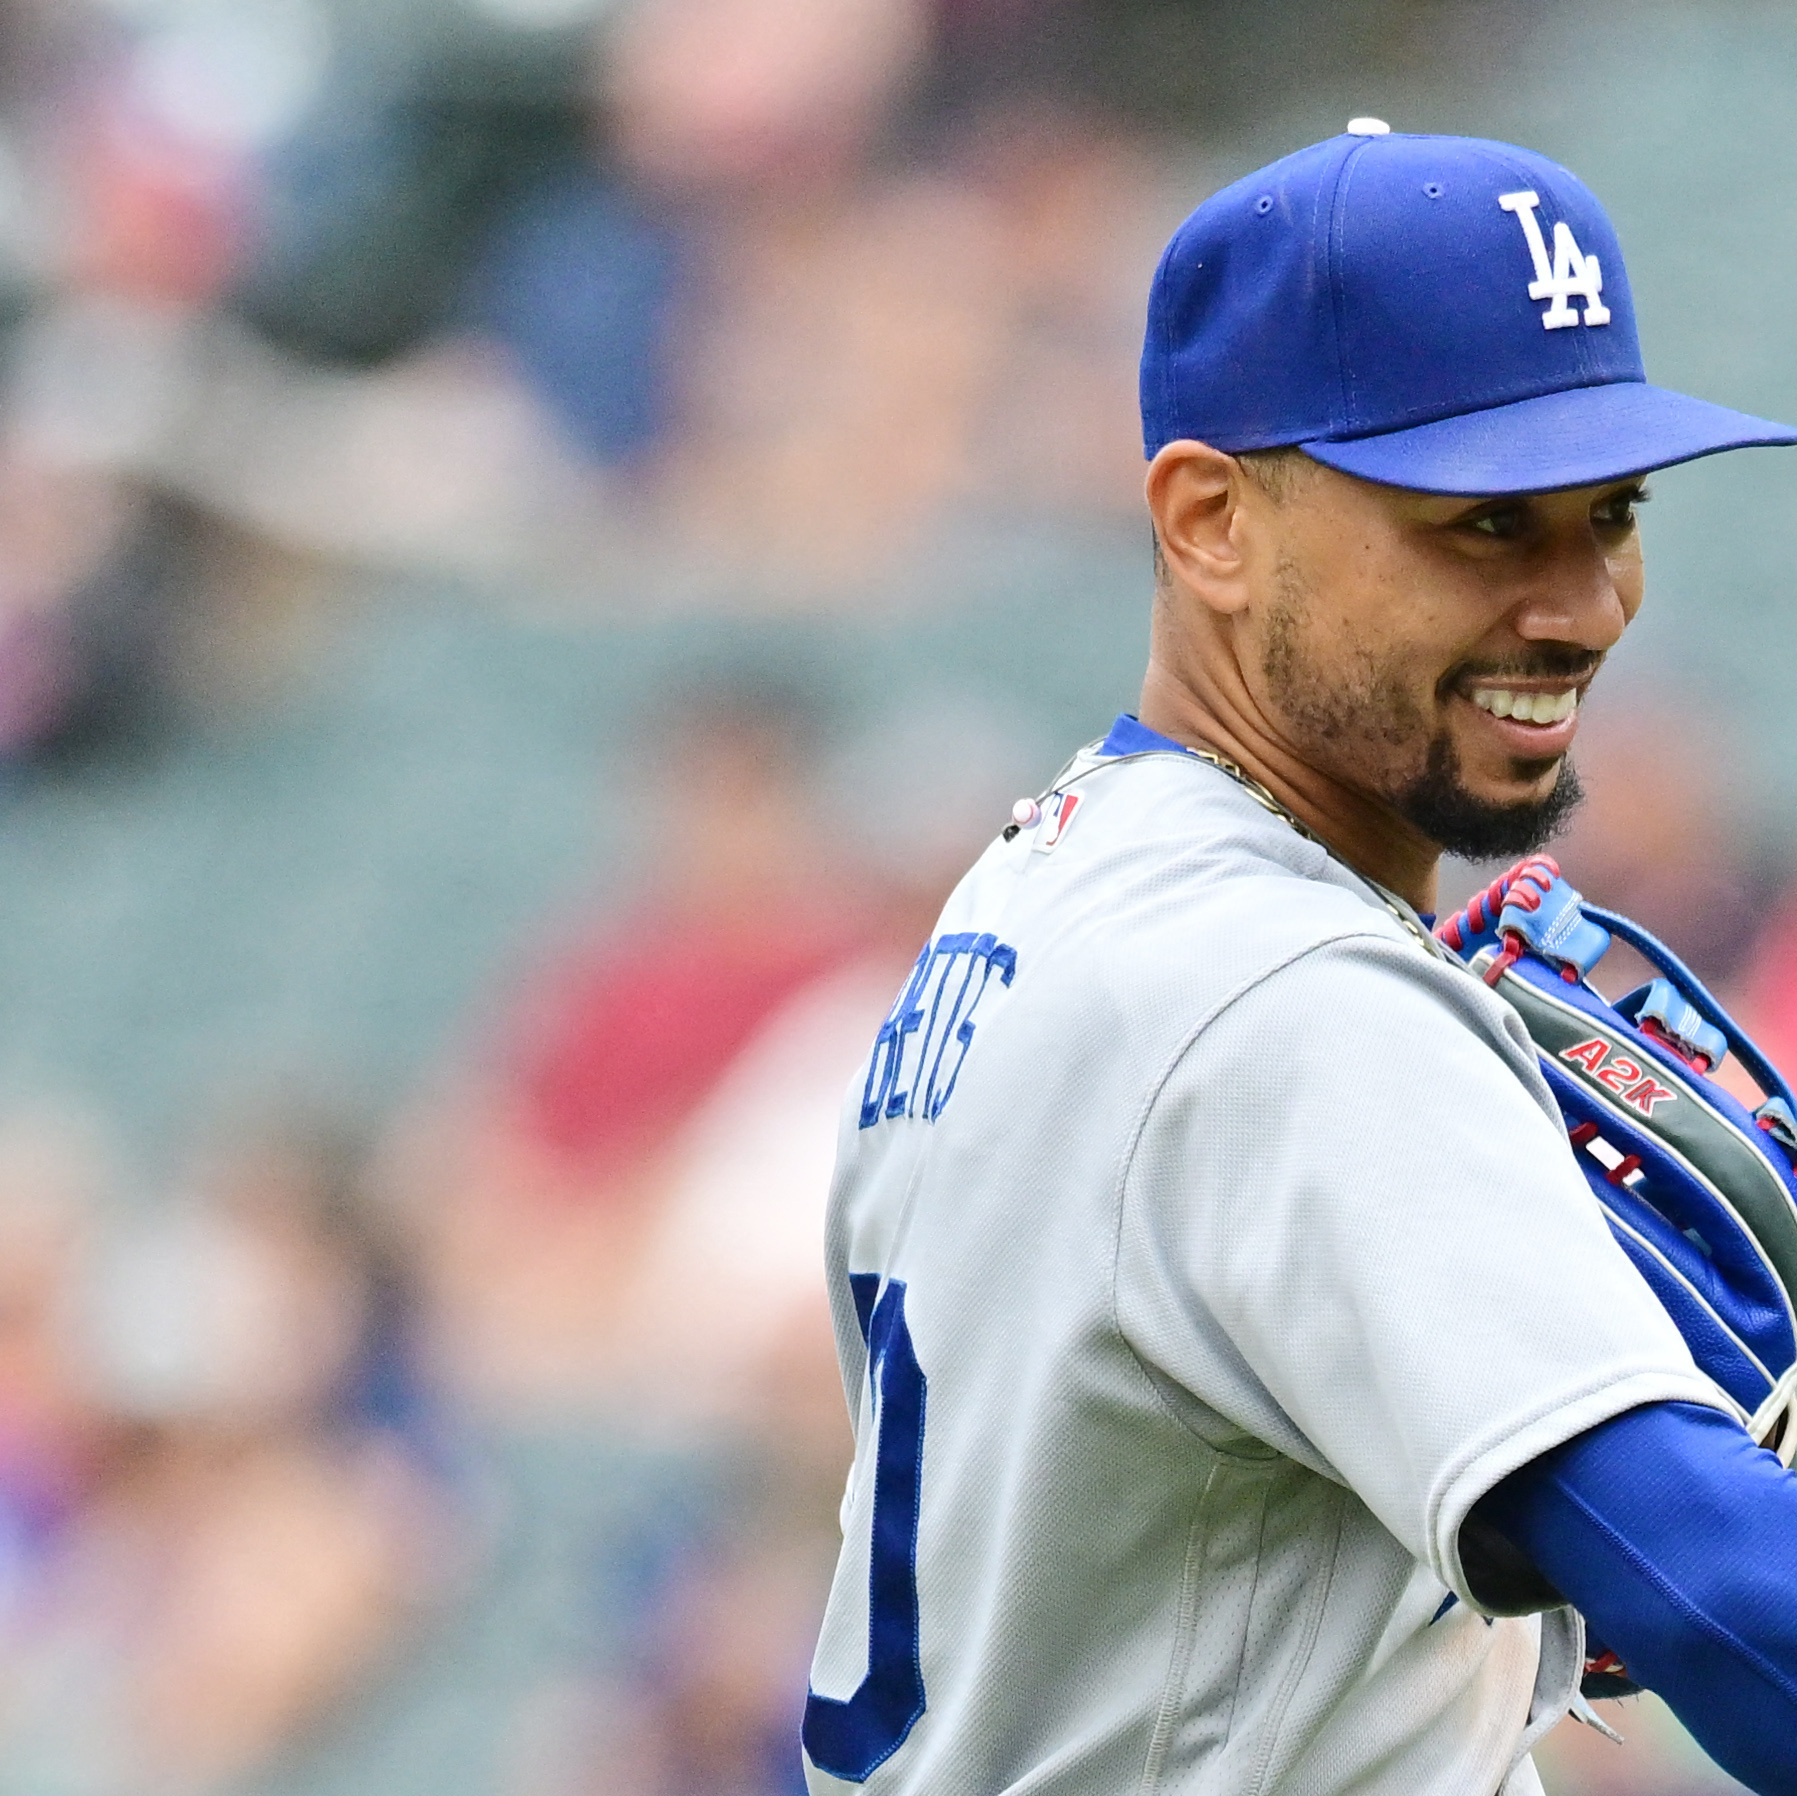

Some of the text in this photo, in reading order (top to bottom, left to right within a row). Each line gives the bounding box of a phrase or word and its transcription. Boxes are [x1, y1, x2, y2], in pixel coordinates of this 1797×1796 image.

[1498, 190, 1611, 330] LA
[858, 931, 1018, 1130] BETTS
[1558, 1037, 1678, 1118] A2K
